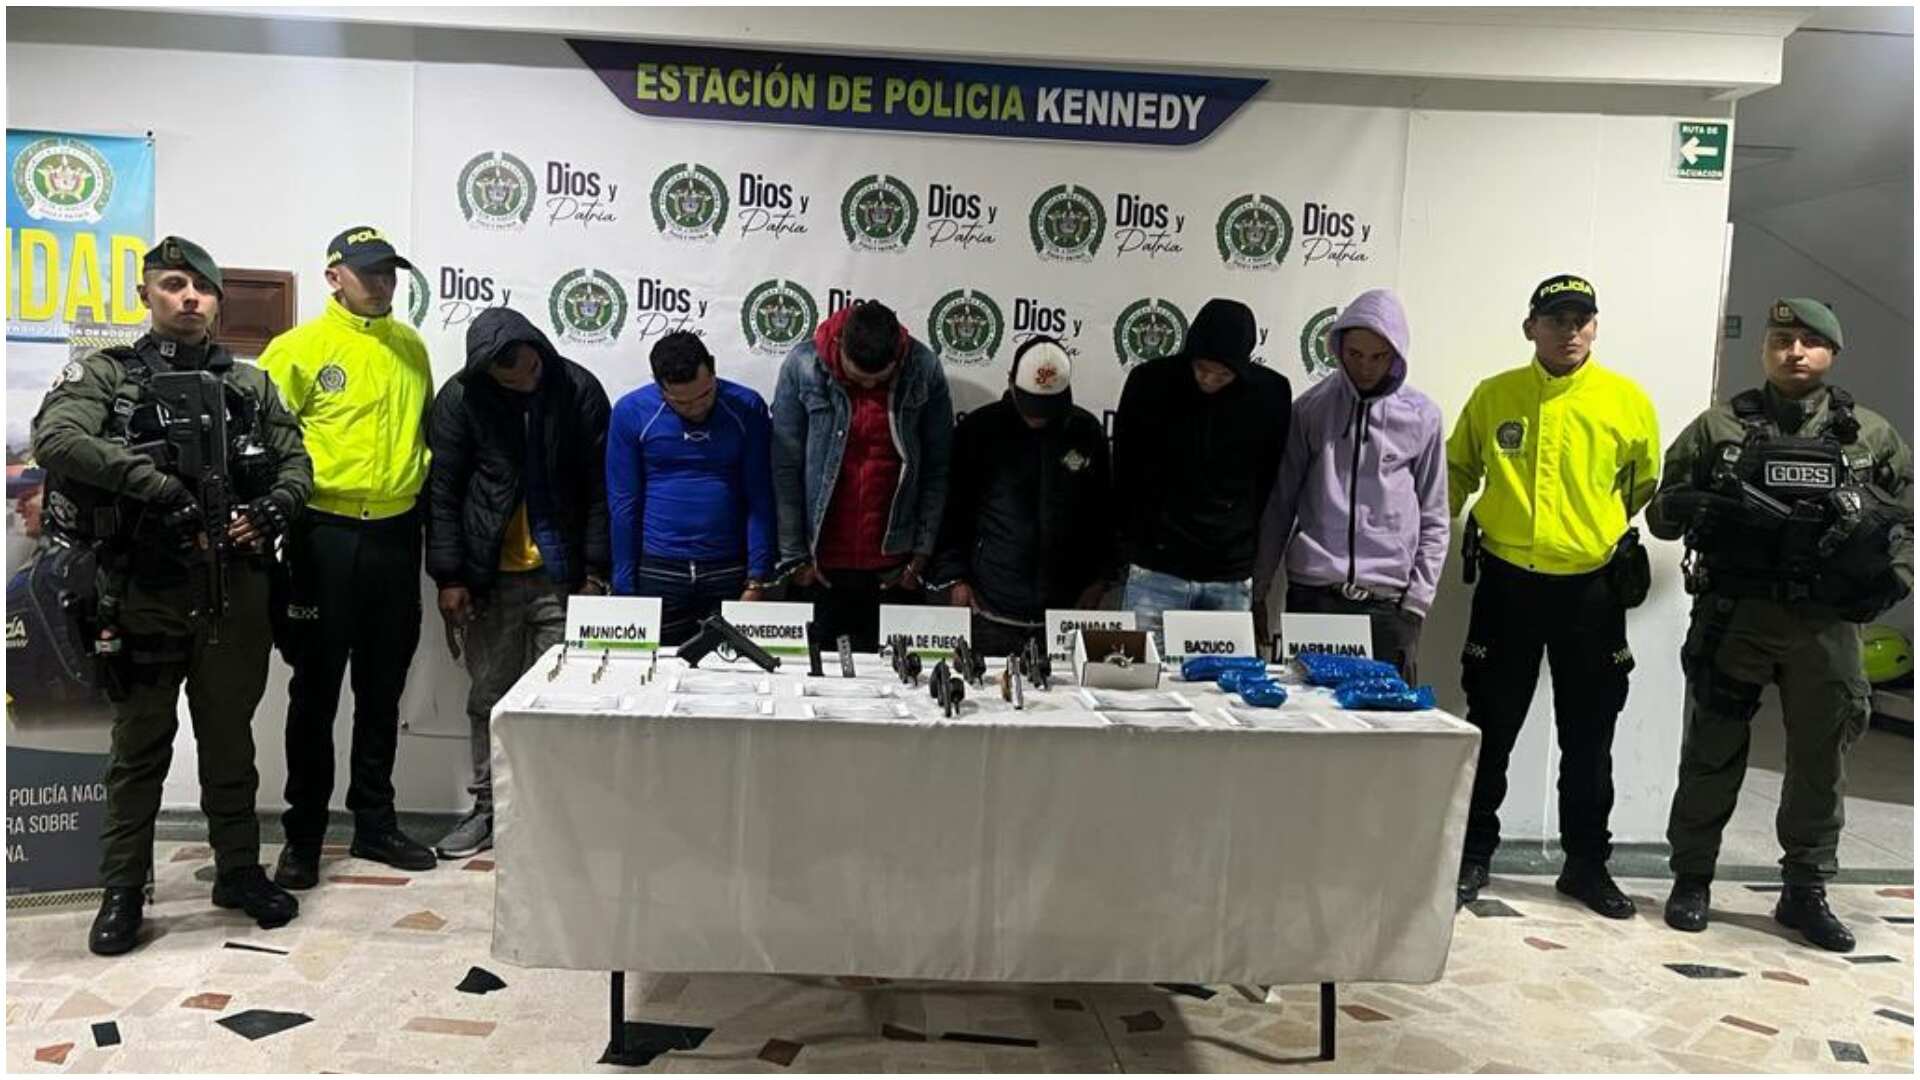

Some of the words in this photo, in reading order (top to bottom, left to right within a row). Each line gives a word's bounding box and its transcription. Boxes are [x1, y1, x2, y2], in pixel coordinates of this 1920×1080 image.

[637, 62, 815, 109] ESTACIÓN
[827, 75, 872, 112] DE
[884, 78, 1025, 121] POLICIA
[1036, 87, 1206, 130] KENNEDY
[1682, 126, 1704, 134] RUTA
[1706, 127, 1718, 135] DE
[547, 161, 600, 197] Dios
[608, 184, 617, 202] y
[739, 172, 792, 209] Dios
[800, 196, 809, 214] y
[546, 197, 616, 228] Patria
[928, 183, 980, 220] Dios
[988, 206, 997, 224] y
[1116, 193, 1168, 229] Dios
[1175, 214, 1185, 233] y
[738, 208, 808, 239] Patria
[927, 219, 996, 250] Patria
[1303, 202, 1354, 238] Dios
[1361, 225, 1370, 242] y
[1114, 229, 1183, 259] Patria
[1302, 238, 1369, 267] Patria
[441, 266, 494, 302] Dios
[501, 289, 511, 307] y
[637, 278, 690, 313] Dios
[699, 301, 707, 318] y
[1014, 298, 1066, 333] Dios
[1072, 319, 1082, 337] y
[1260, 327, 1268, 345] y
[1771, 466, 1829, 483] GOES
[579, 623, 647, 639] MUNICIÓN
[916, 635, 929, 648] DE
[932, 635, 960, 648] FUEG
[1184, 640, 1235, 654] BAZUCO
[9, 783, 68, 806] POLICÍA
[29, 812, 79, 833] SOBRE
